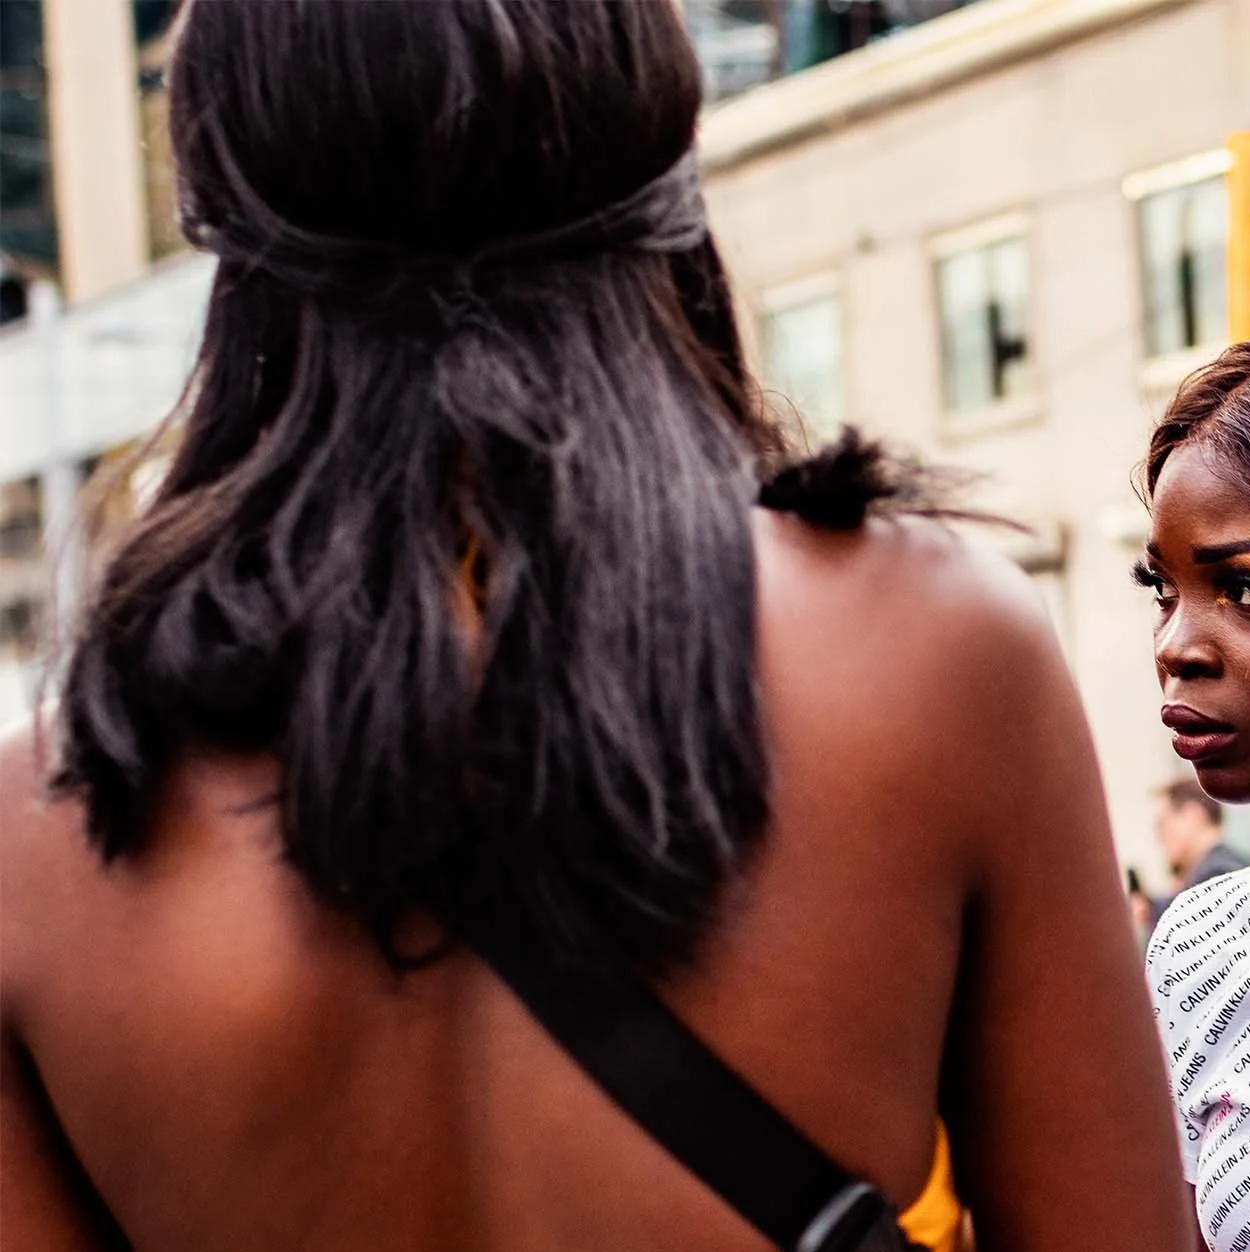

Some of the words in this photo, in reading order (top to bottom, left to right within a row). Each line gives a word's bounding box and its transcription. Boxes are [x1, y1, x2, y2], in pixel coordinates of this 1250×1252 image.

[1179, 974, 1221, 1013] CALVIN
[1203, 1003, 1237, 1046] CALVIN
[1179, 1051, 1207, 1092] JEANS
[1208, 1153, 1239, 1185] KLEIN
[1208, 1202, 1231, 1238] CALVIN
